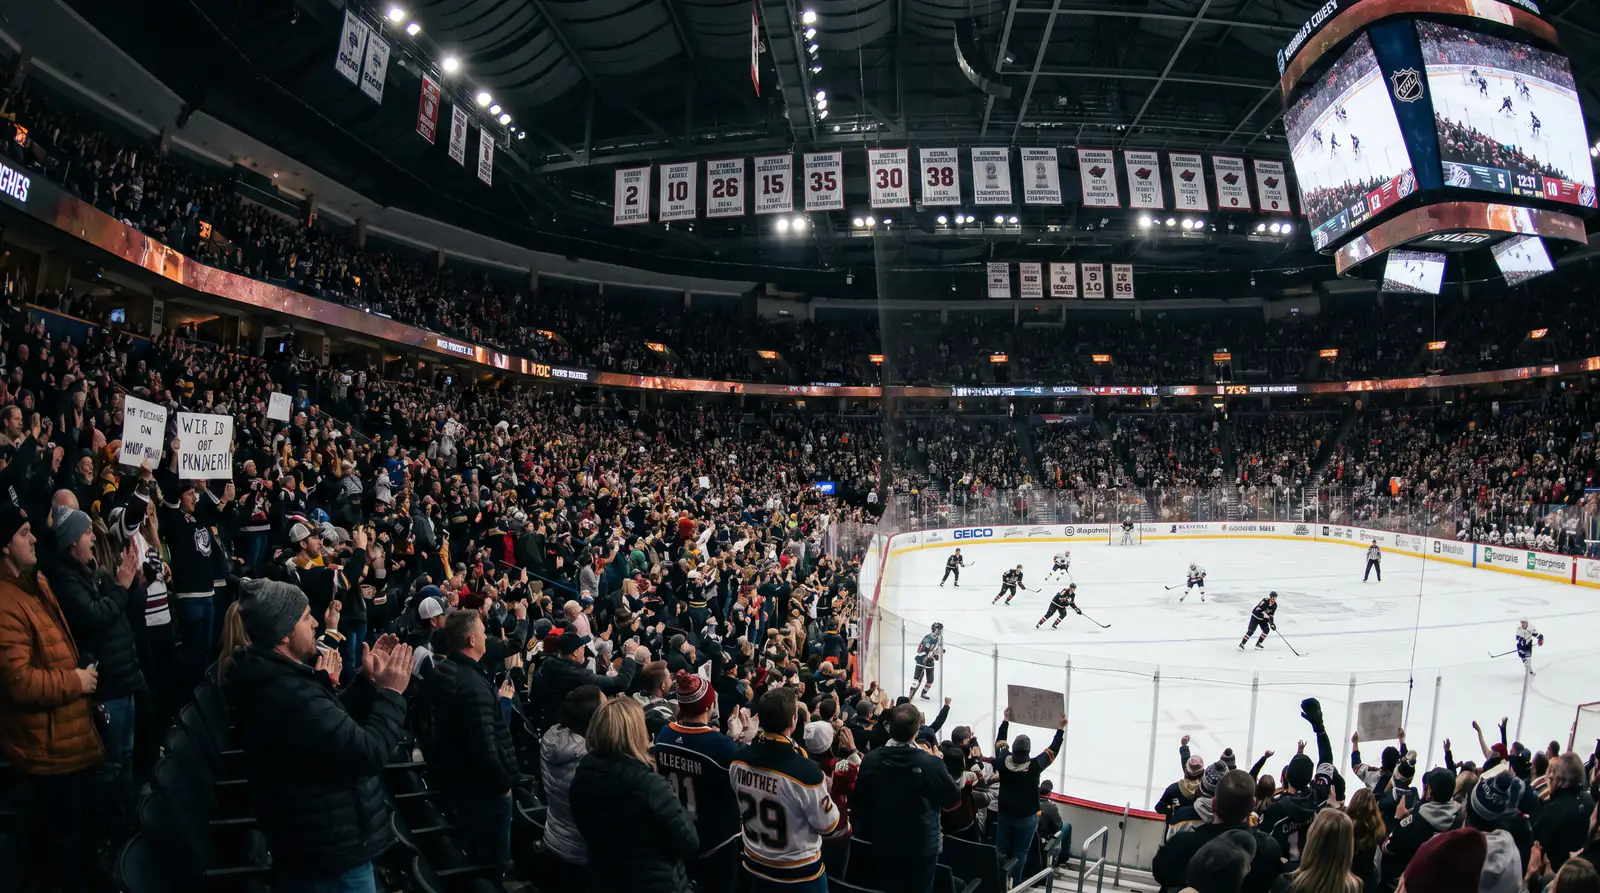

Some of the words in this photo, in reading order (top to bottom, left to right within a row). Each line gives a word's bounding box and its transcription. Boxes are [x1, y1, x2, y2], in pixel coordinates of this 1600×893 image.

[1400, 77, 1415, 96] NHL
[0, 162, 30, 202] GHES
[762, 174, 784, 195] 15
[810, 171, 837, 192] 35
[876, 168, 902, 189] 30
[927, 167, 954, 187] 38
[1497, 173, 1506, 189] 5
[626, 185, 639, 206] 2
[667, 181, 688, 202] 10
[712, 177, 738, 198] 26
[1546, 181, 1558, 196] 10
[1340, 215, 1347, 229] 5
[1085, 283, 1102, 291] 10
[140, 424, 152, 436] ON
[182, 417, 208, 435] WIR
[214, 421, 225, 435] IS
[953, 528, 993, 539] GEICO
[737, 790, 788, 850] 29
